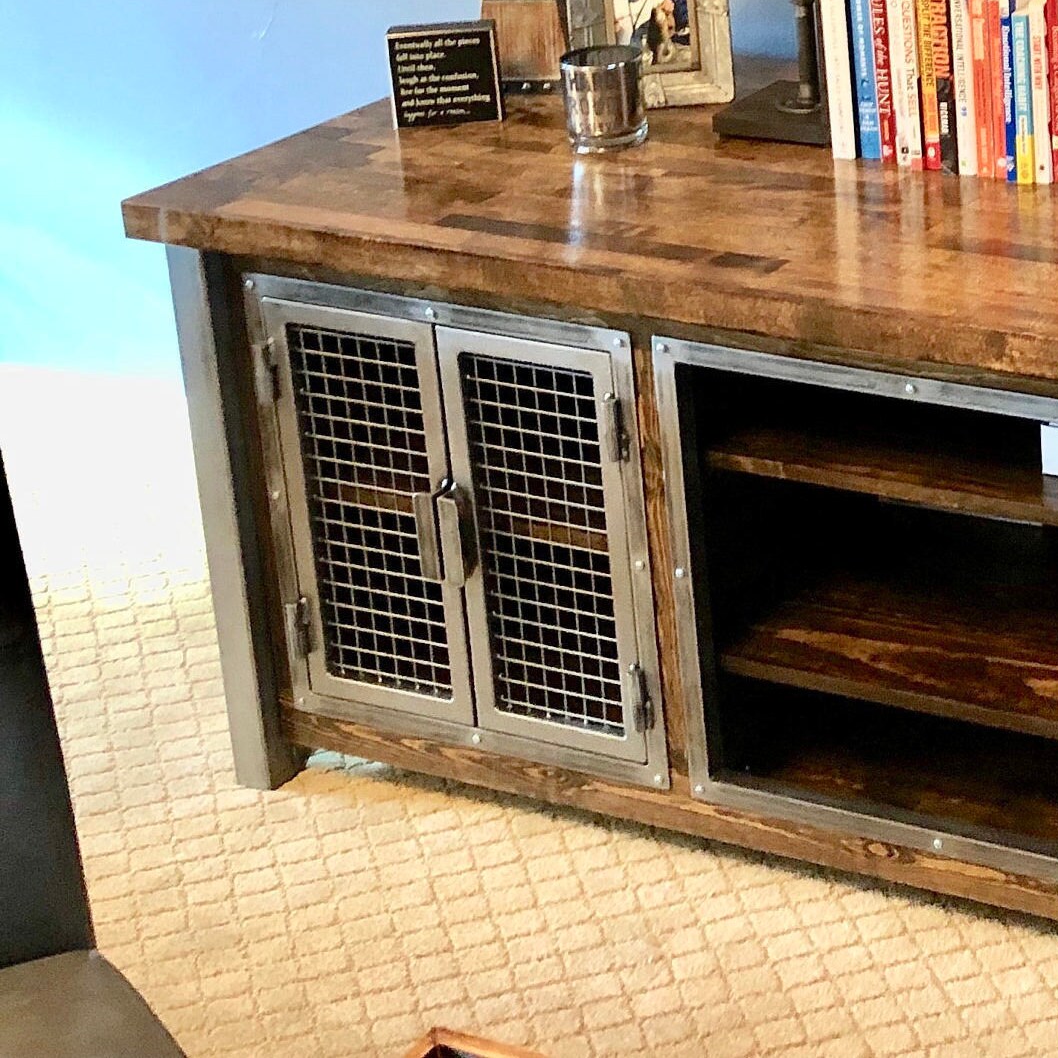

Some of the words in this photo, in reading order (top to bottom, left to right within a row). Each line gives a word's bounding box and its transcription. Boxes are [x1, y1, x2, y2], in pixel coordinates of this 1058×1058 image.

[901, 1, 913, 64] QUESTIONS
[922, 22, 932, 38] THE
[1001, 25, 1012, 72] Emotional
[923, 39, 934, 87] DIFFERENCE
[876, 68, 891, 114] HUNT
[1003, 72, 1013, 123] Intelligence
